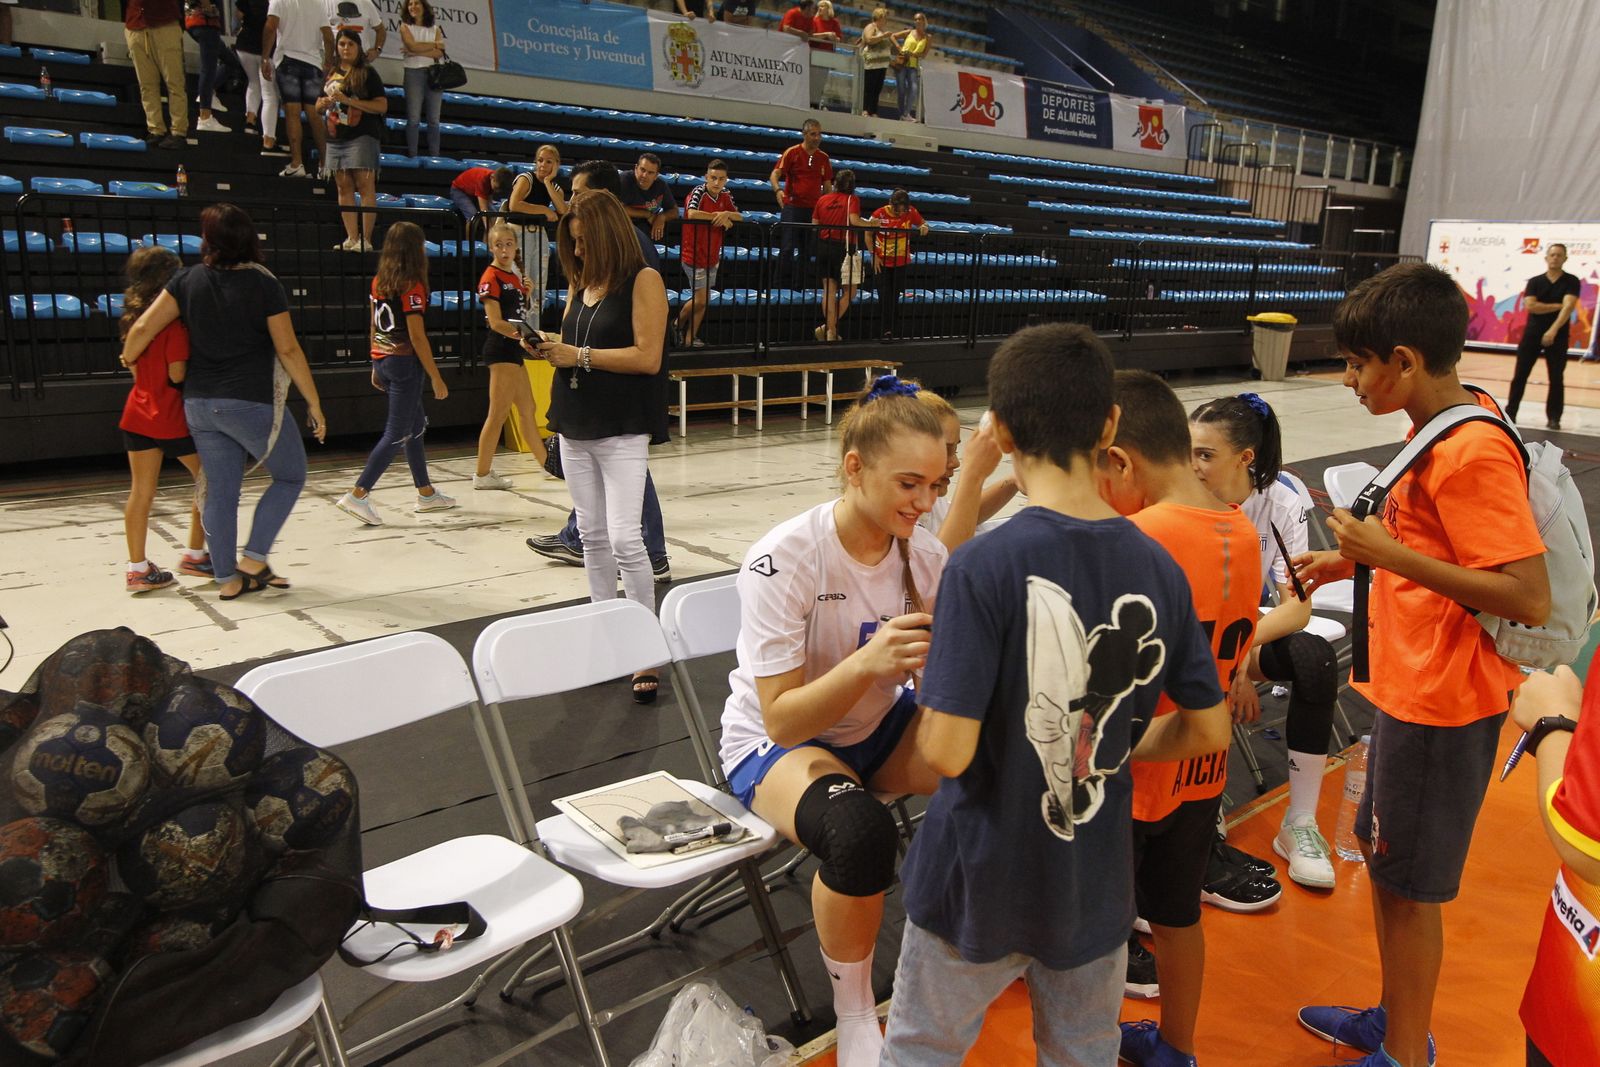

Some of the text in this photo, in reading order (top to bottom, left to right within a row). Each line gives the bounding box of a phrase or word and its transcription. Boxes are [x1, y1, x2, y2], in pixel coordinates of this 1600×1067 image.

[528, 17, 619, 44] Concejalía de
[503, 32, 645, 66] Deportes y Juventud
[710, 50, 803, 75] AYUNTAMIENTO
[711, 65, 784, 86] DE ALMERÍA
[1042, 94, 1095, 113] DEPORTES
[1043, 108, 1096, 126] DE ALMERIA
[35, 752, 117, 783] molten
